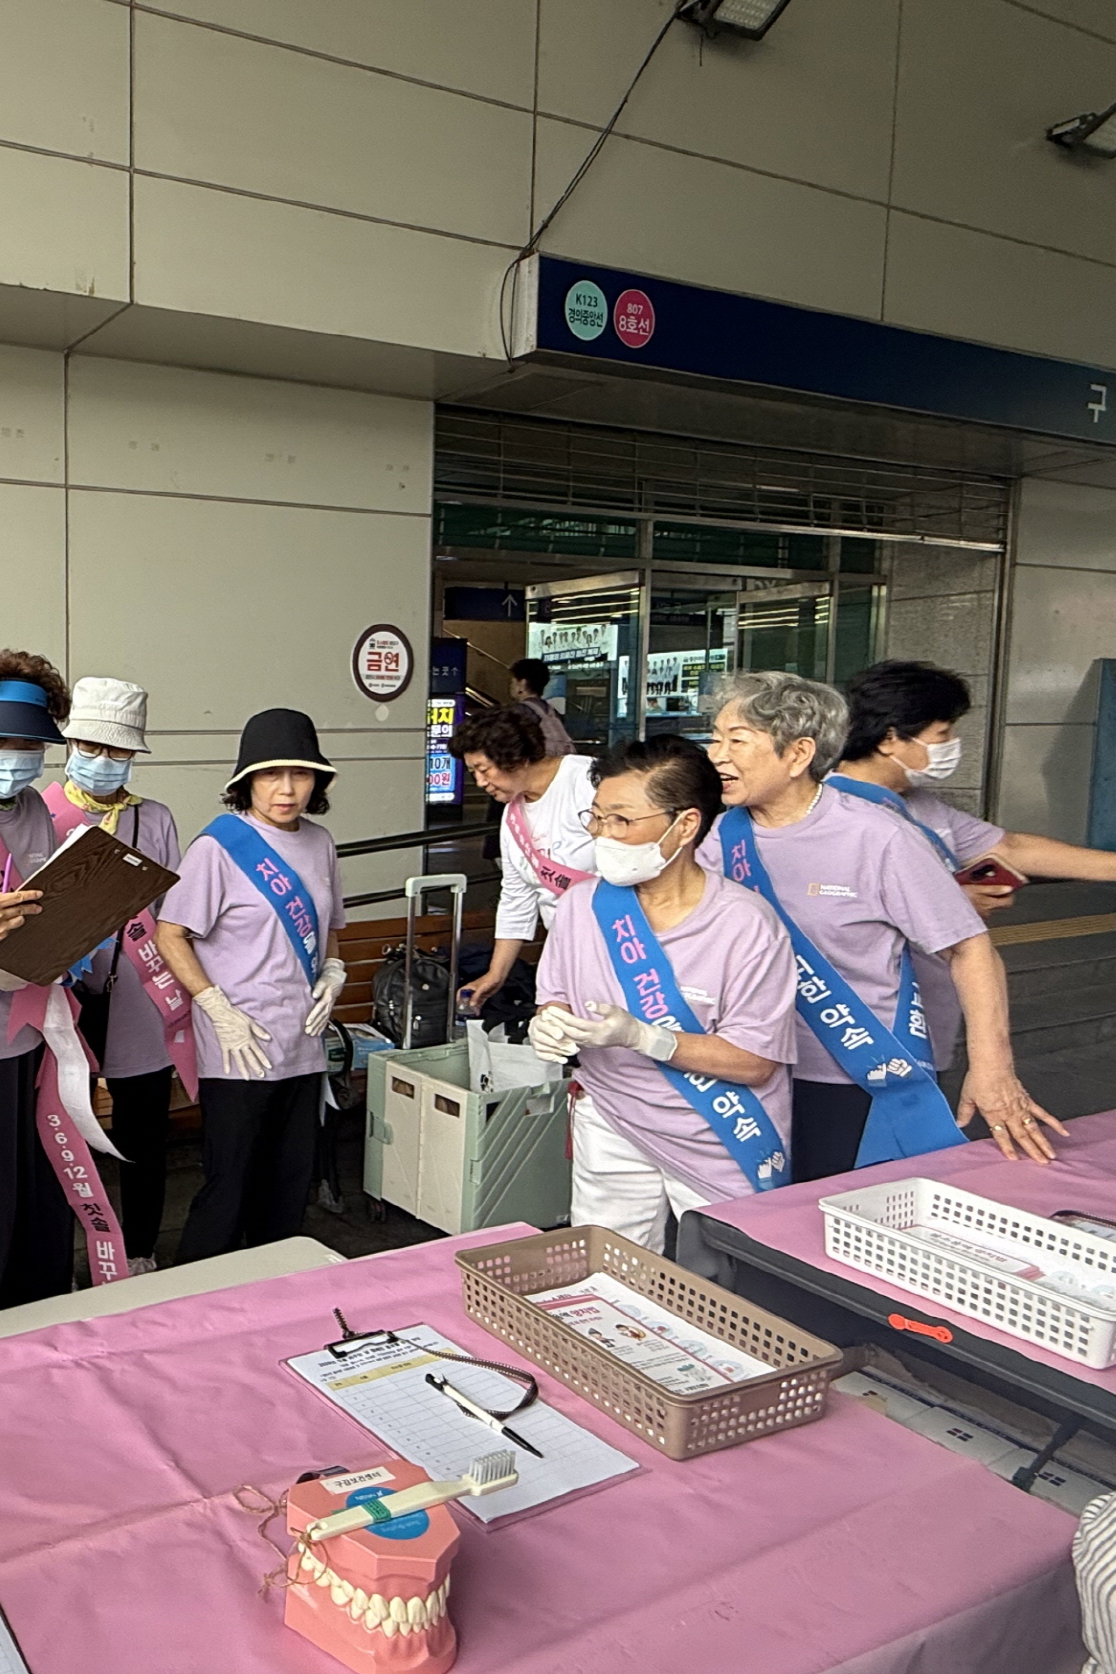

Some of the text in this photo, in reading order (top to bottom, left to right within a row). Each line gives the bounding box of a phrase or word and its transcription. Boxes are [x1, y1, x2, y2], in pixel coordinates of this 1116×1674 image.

[576, 293, 598, 307] K123
[627, 303, 643, 315] 807
[568, 307, 603, 327] 경의중앙선
[619, 315, 649, 335] 8호선
[367, 651, 399, 672] 금연
[731, 839, 752, 882] 치아
[256, 858, 292, 897] 치아
[540, 866, 571, 890] 칫솔
[127, 916, 147, 942] 솔
[138, 939, 175, 990] 바꾸는
[165, 989, 184, 1011] 날
[612, 915, 647, 964] 치아
[712, 1091, 761, 1142] 약속
[820, 1003, 874, 1050] 약속
[81, 1203, 111, 1233] 칫솔
[96, 1240, 118, 1285] 바꾸
